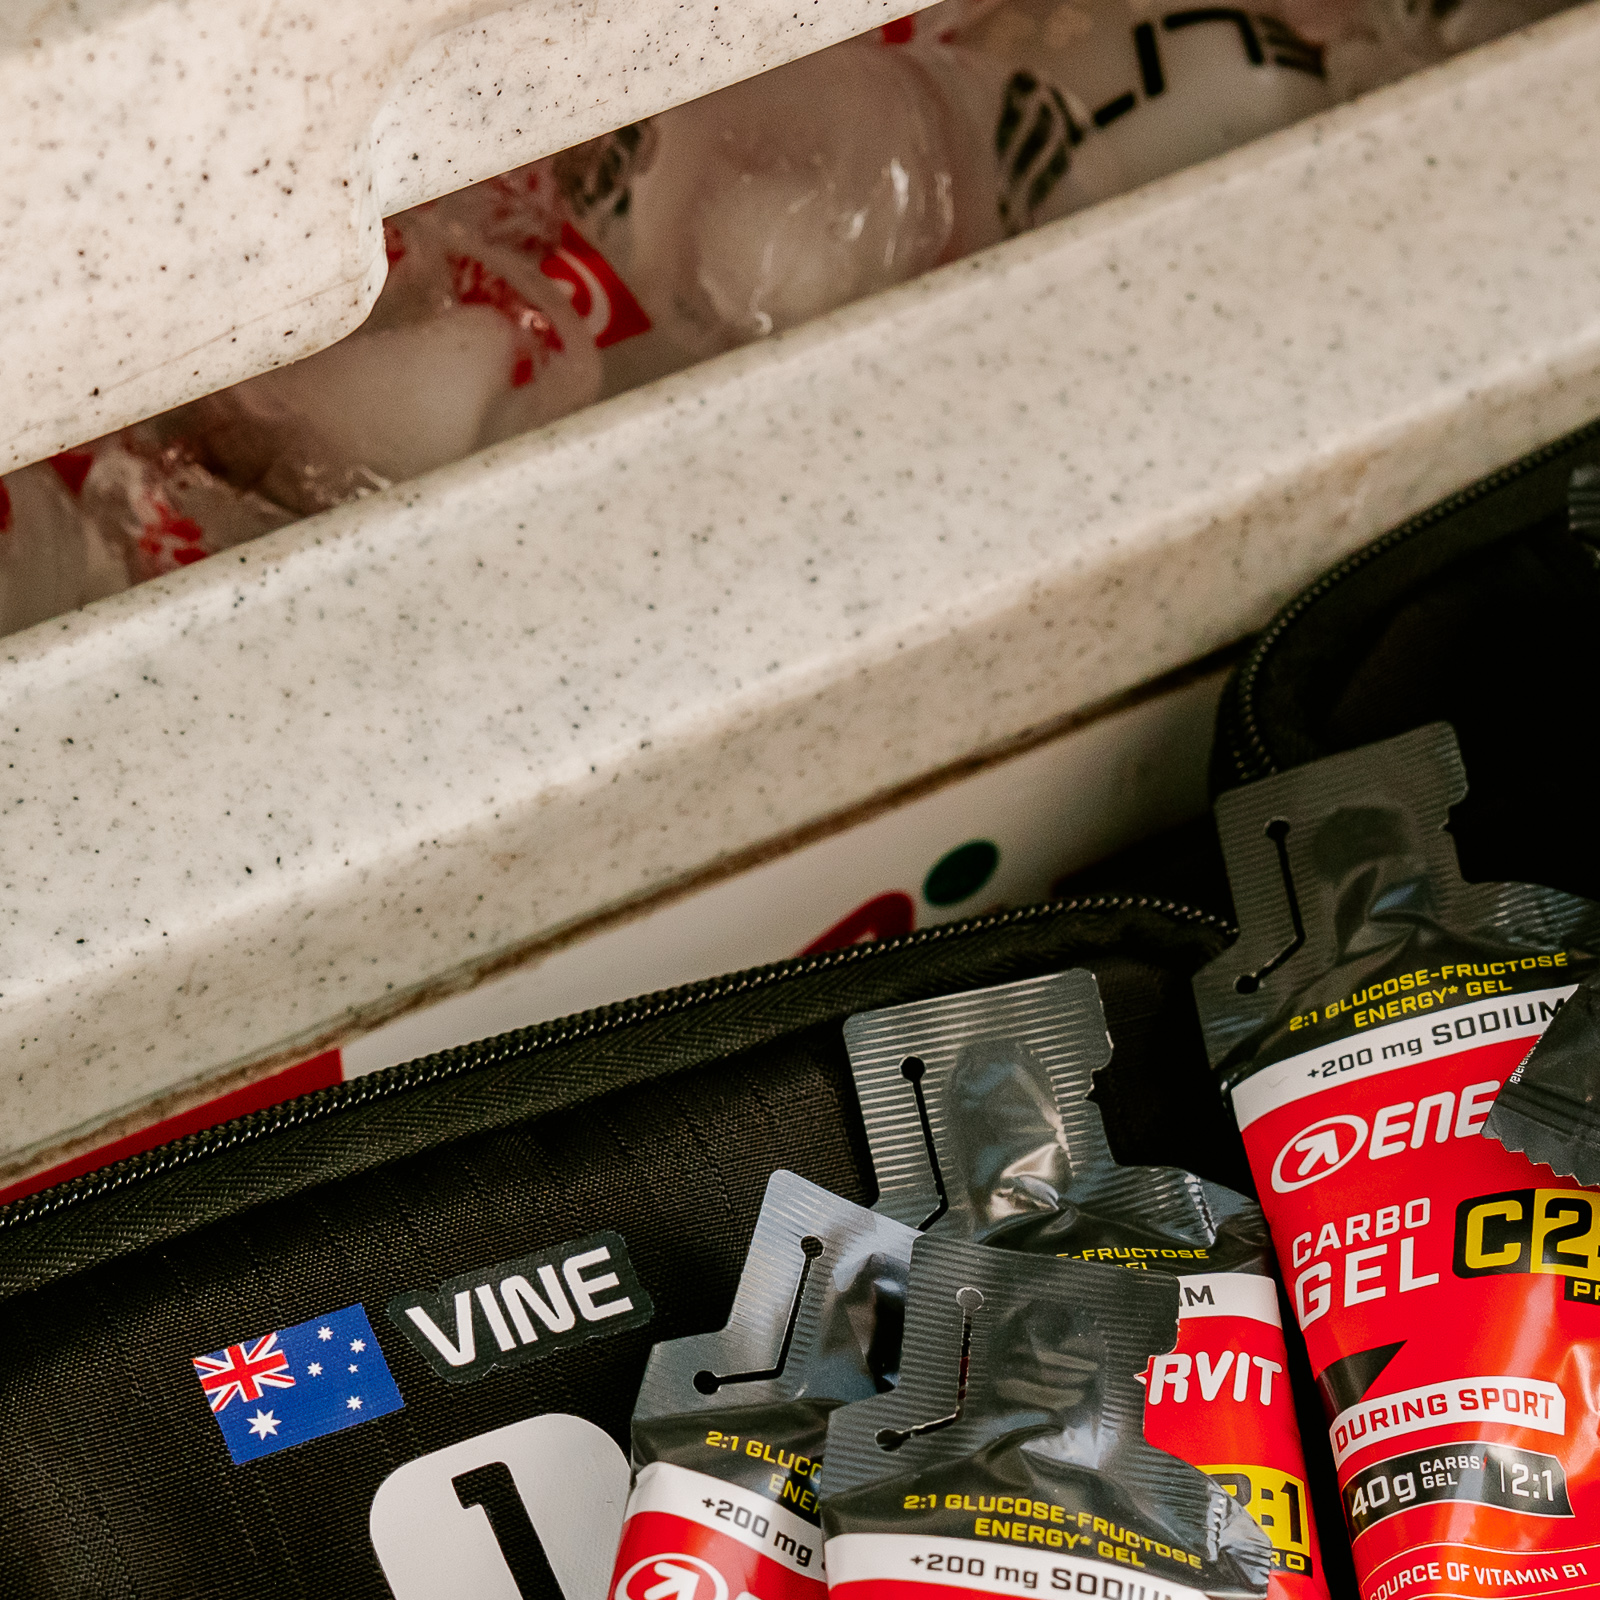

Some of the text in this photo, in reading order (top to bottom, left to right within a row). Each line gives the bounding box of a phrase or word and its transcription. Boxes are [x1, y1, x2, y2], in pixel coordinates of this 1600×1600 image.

[1289, 951, 1569, 1032] 2:1 GLUCOSE-FRUCTOSE
[1465, 979, 1513, 997] GEL
[1307, 998, 1565, 1080] +200 mg SODIUM
[1056, 1247, 1209, 1262] -FRUCTOSE
[1292, 1197, 1431, 1269] CARBO
[404, 1245, 634, 1367] VINE
[1294, 1236, 1440, 1333] GEL
[1147, 1350, 1283, 1406] RVIT
[706, 1430, 740, 1452] 2:1
[1335, 1387, 1555, 1453] DURING SPORT
[769, 1475, 822, 1513] ENER
[1351, 1472, 1417, 1517] 40g
[1422, 1471, 1458, 1489] GEL
[1511, 1462, 1555, 1501] 2:1
[701, 1497, 814, 1567] +200 mg
[903, 1492, 1203, 1570] 2:1 GLUCOSE-FRUCTOSE
[1200, 1473, 1305, 1548] 2:1
[909, 1553, 985, 1577] +200
[994, 1565, 1039, 1589] mg
[1096, 1542, 1147, 1569] GEL
[1271, 1552, 1306, 1571] RO
[1446, 1560, 1471, 1581] OF
[1473, 1565, 1557, 1586] VITAMIN
[1562, 1562, 1588, 1579] B1
